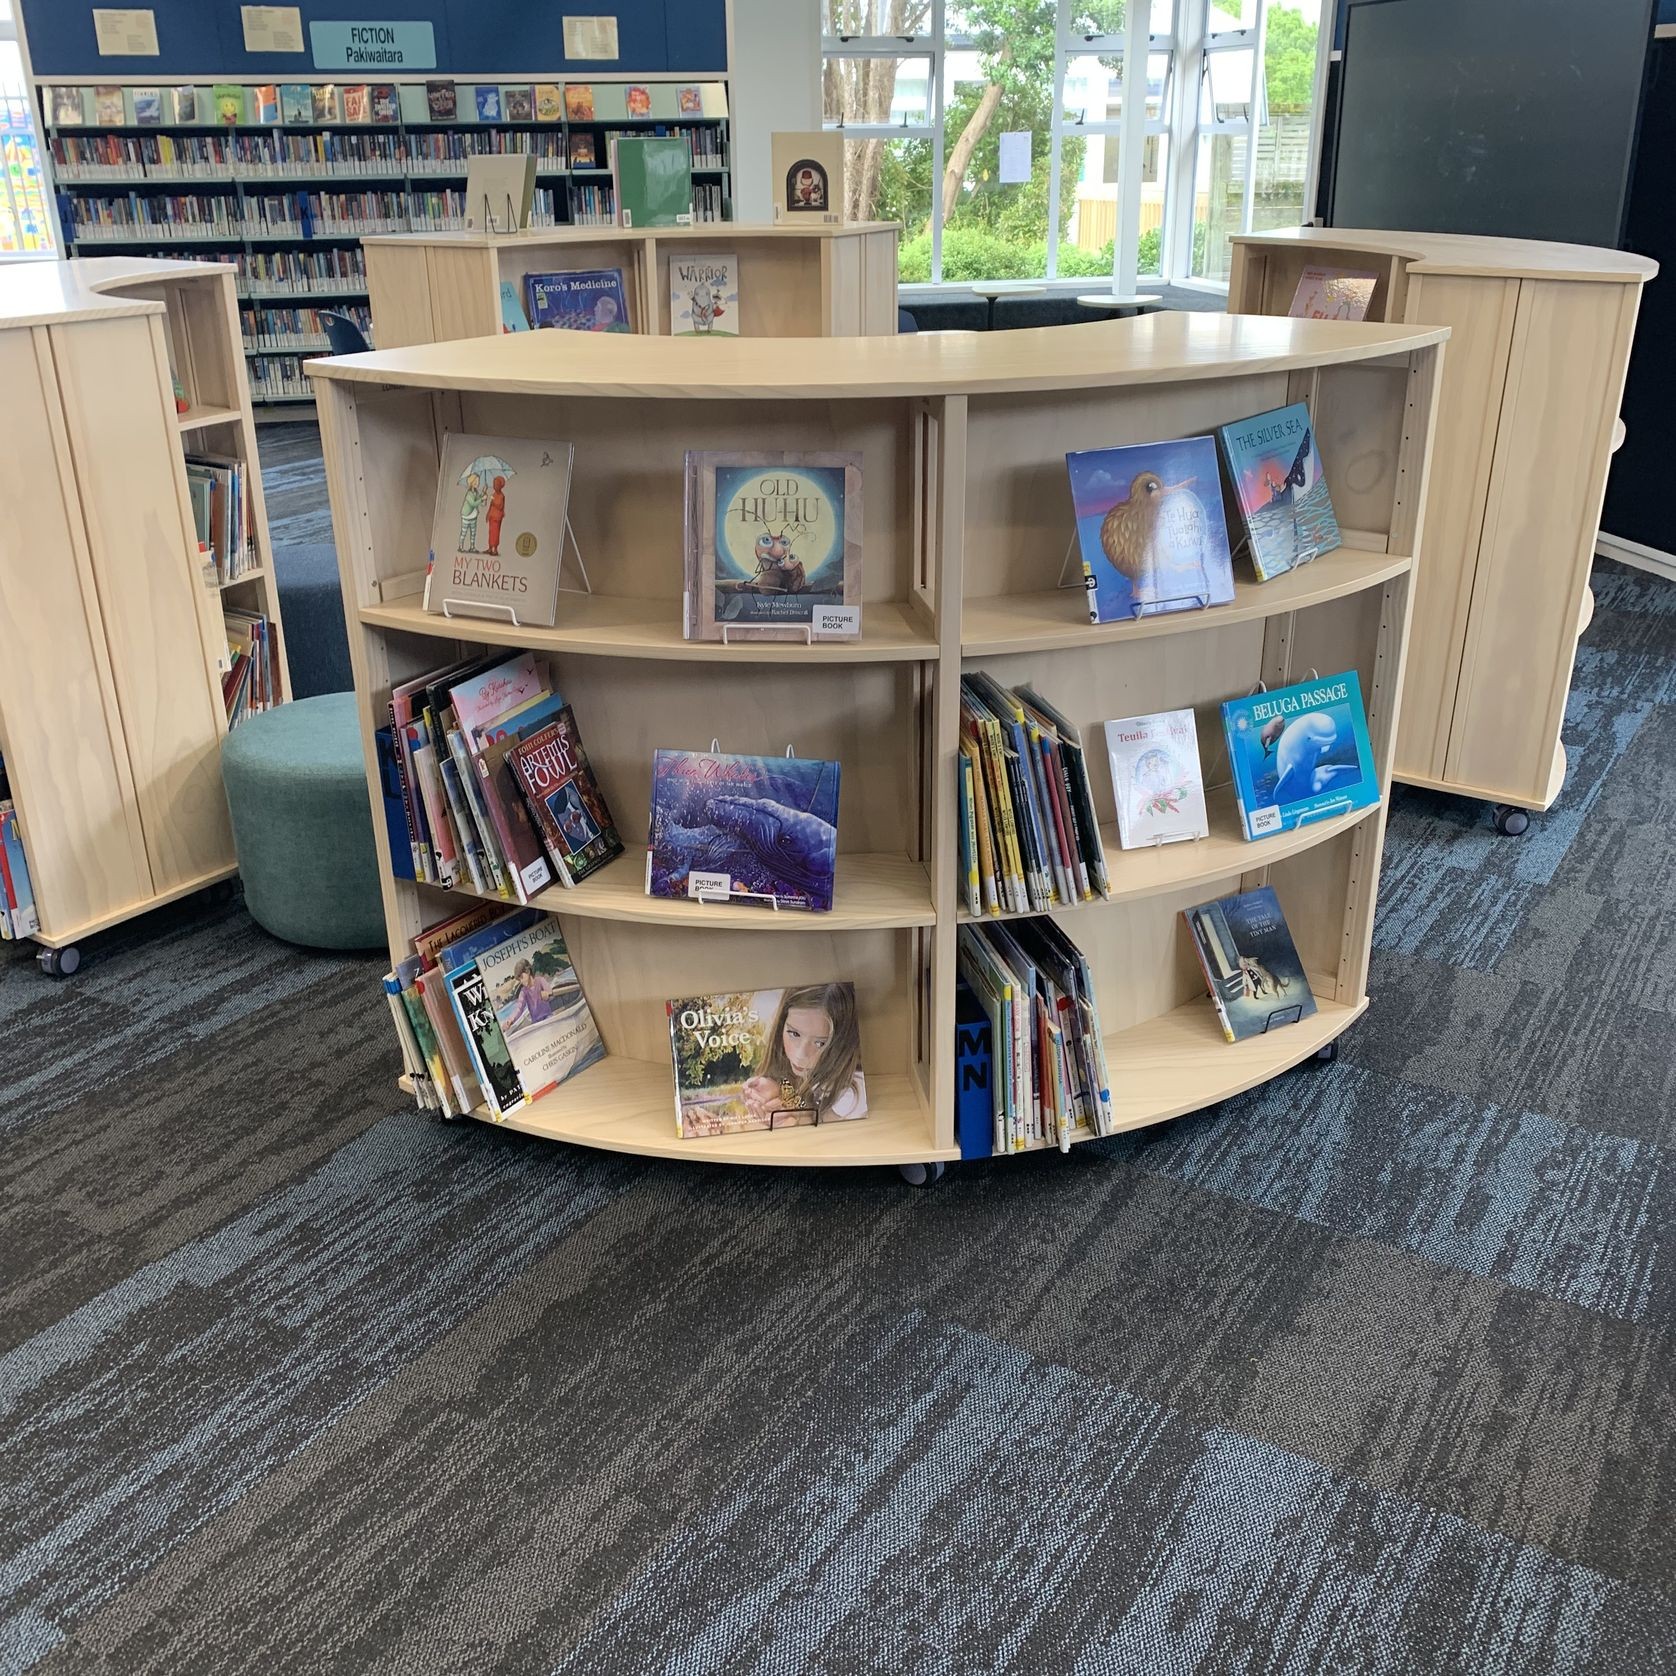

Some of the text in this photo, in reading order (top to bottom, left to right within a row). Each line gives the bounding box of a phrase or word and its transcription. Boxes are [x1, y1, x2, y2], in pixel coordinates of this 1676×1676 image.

[351, 27, 395, 44] FICTION
[346, 46, 404, 63] Pakiwaitara
[535, 279, 618, 293] Koro's Medicine
[1236, 433, 1257, 452] THE
[1256, 427, 1288, 447] SILVER
[1286, 418, 1303, 434] SEA
[760, 479, 798, 496] OLD
[738, 497, 820, 523] HUHU
[454, 556, 501, 573] MY TWO
[452, 569, 528, 593] BLANKETS
[822, 615, 854, 623] PICTURE
[1252, 682, 1348, 721] BELUGA PASSAGE
[520, 734, 570, 774] ARTEMIS
[525, 750, 578, 794] FOWL
[1255, 812, 1276, 822] PICTURE
[1257, 821, 1271, 829] BOOK
[528, 865, 543, 879] PICTURE
[532, 873, 543, 883] BOOK
[695, 879, 723, 887] PICTURE
[428, 938, 443, 953] THE
[482, 921, 558, 972] JOSEPH'S BOAT
[680, 1006, 760, 1029] Olivia's
[692, 1031, 751, 1049] Voice
[958, 1026, 992, 1058] M
[523, 1045, 550, 1066] CAROLINE
[962, 1062, 987, 1091] N
